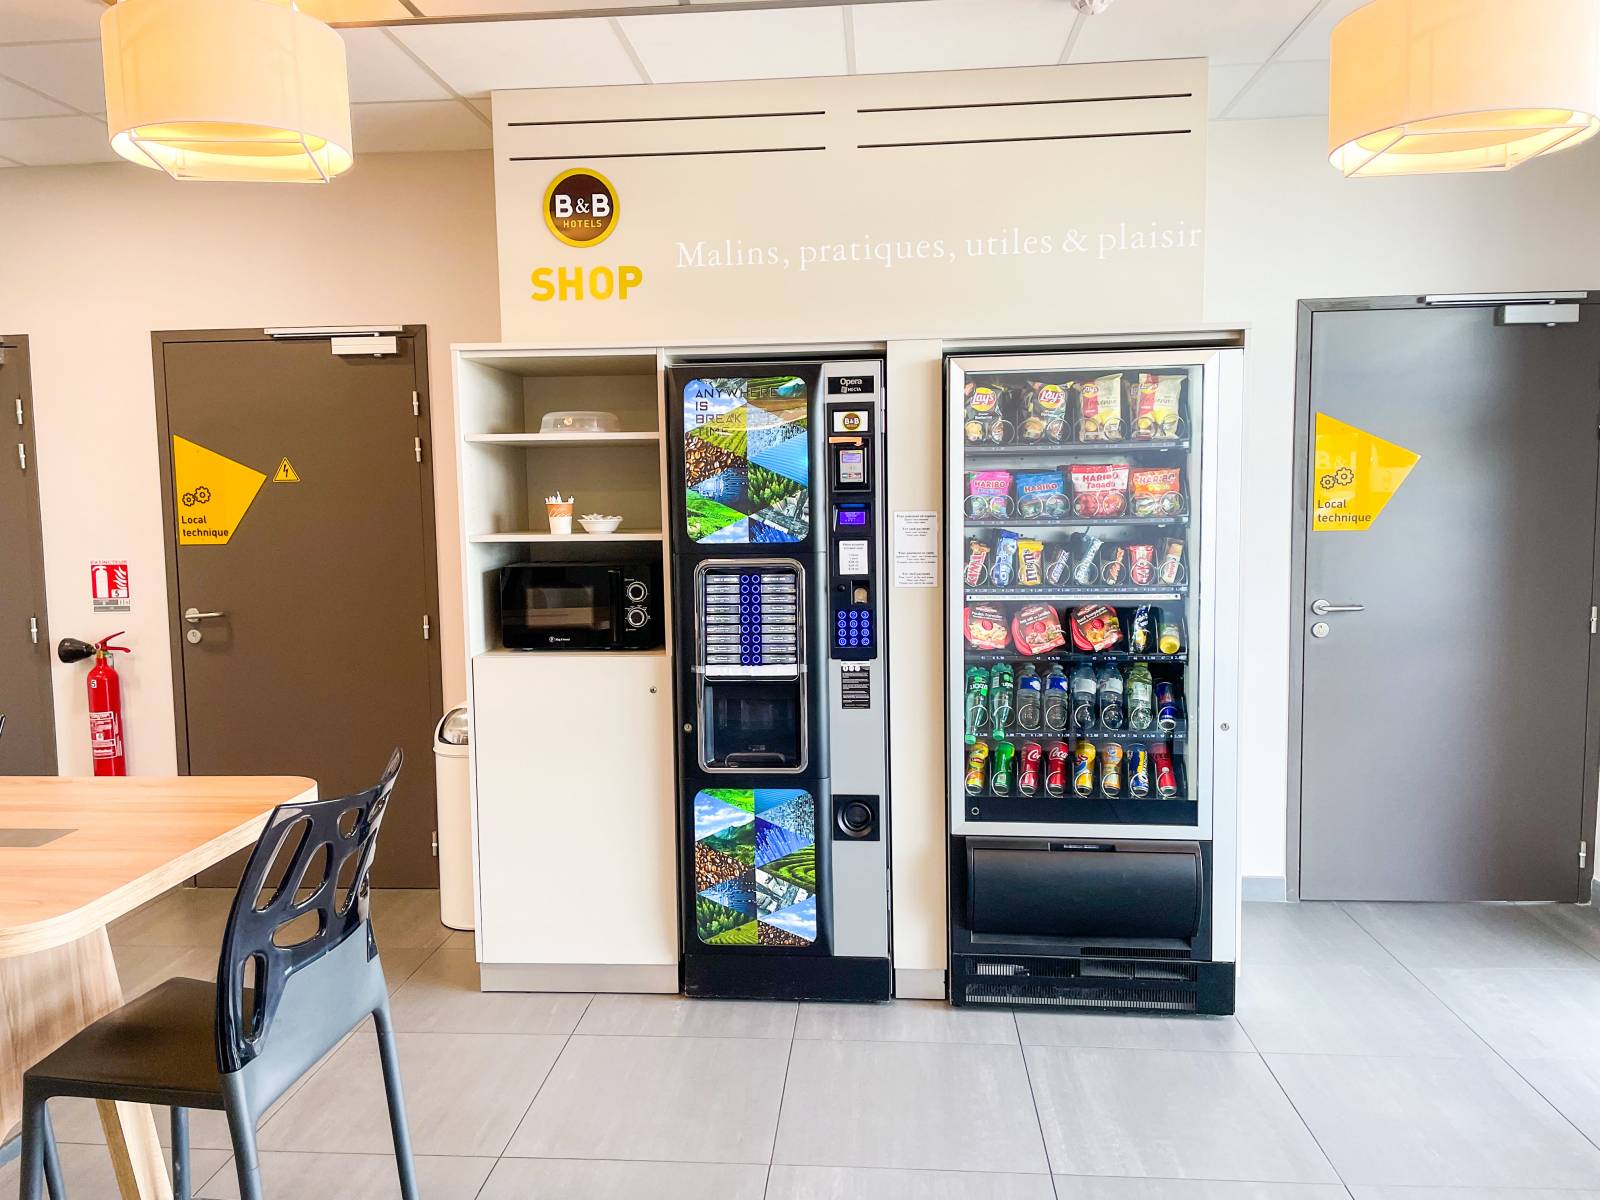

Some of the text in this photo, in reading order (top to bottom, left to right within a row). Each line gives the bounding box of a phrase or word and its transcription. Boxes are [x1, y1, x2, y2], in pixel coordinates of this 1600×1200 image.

[555, 194, 610, 218] B&B
[563, 219, 602, 229] HOTELS
[676, 220, 1202, 271] Malins, pratiques, utiles & plaisir
[531, 265, 643, 301] SHOP
[840, 378, 863, 386] Opera
[695, 401, 709, 411] IS
[695, 413, 741, 424] BREAK
[1082, 472, 1119, 483] HARIBO
[974, 480, 1007, 488] HARIBO
[1317, 499, 1347, 509] Local
[181, 515, 208, 524] Local
[1317, 513, 1372, 524] technique
[182, 528, 229, 539] technique
